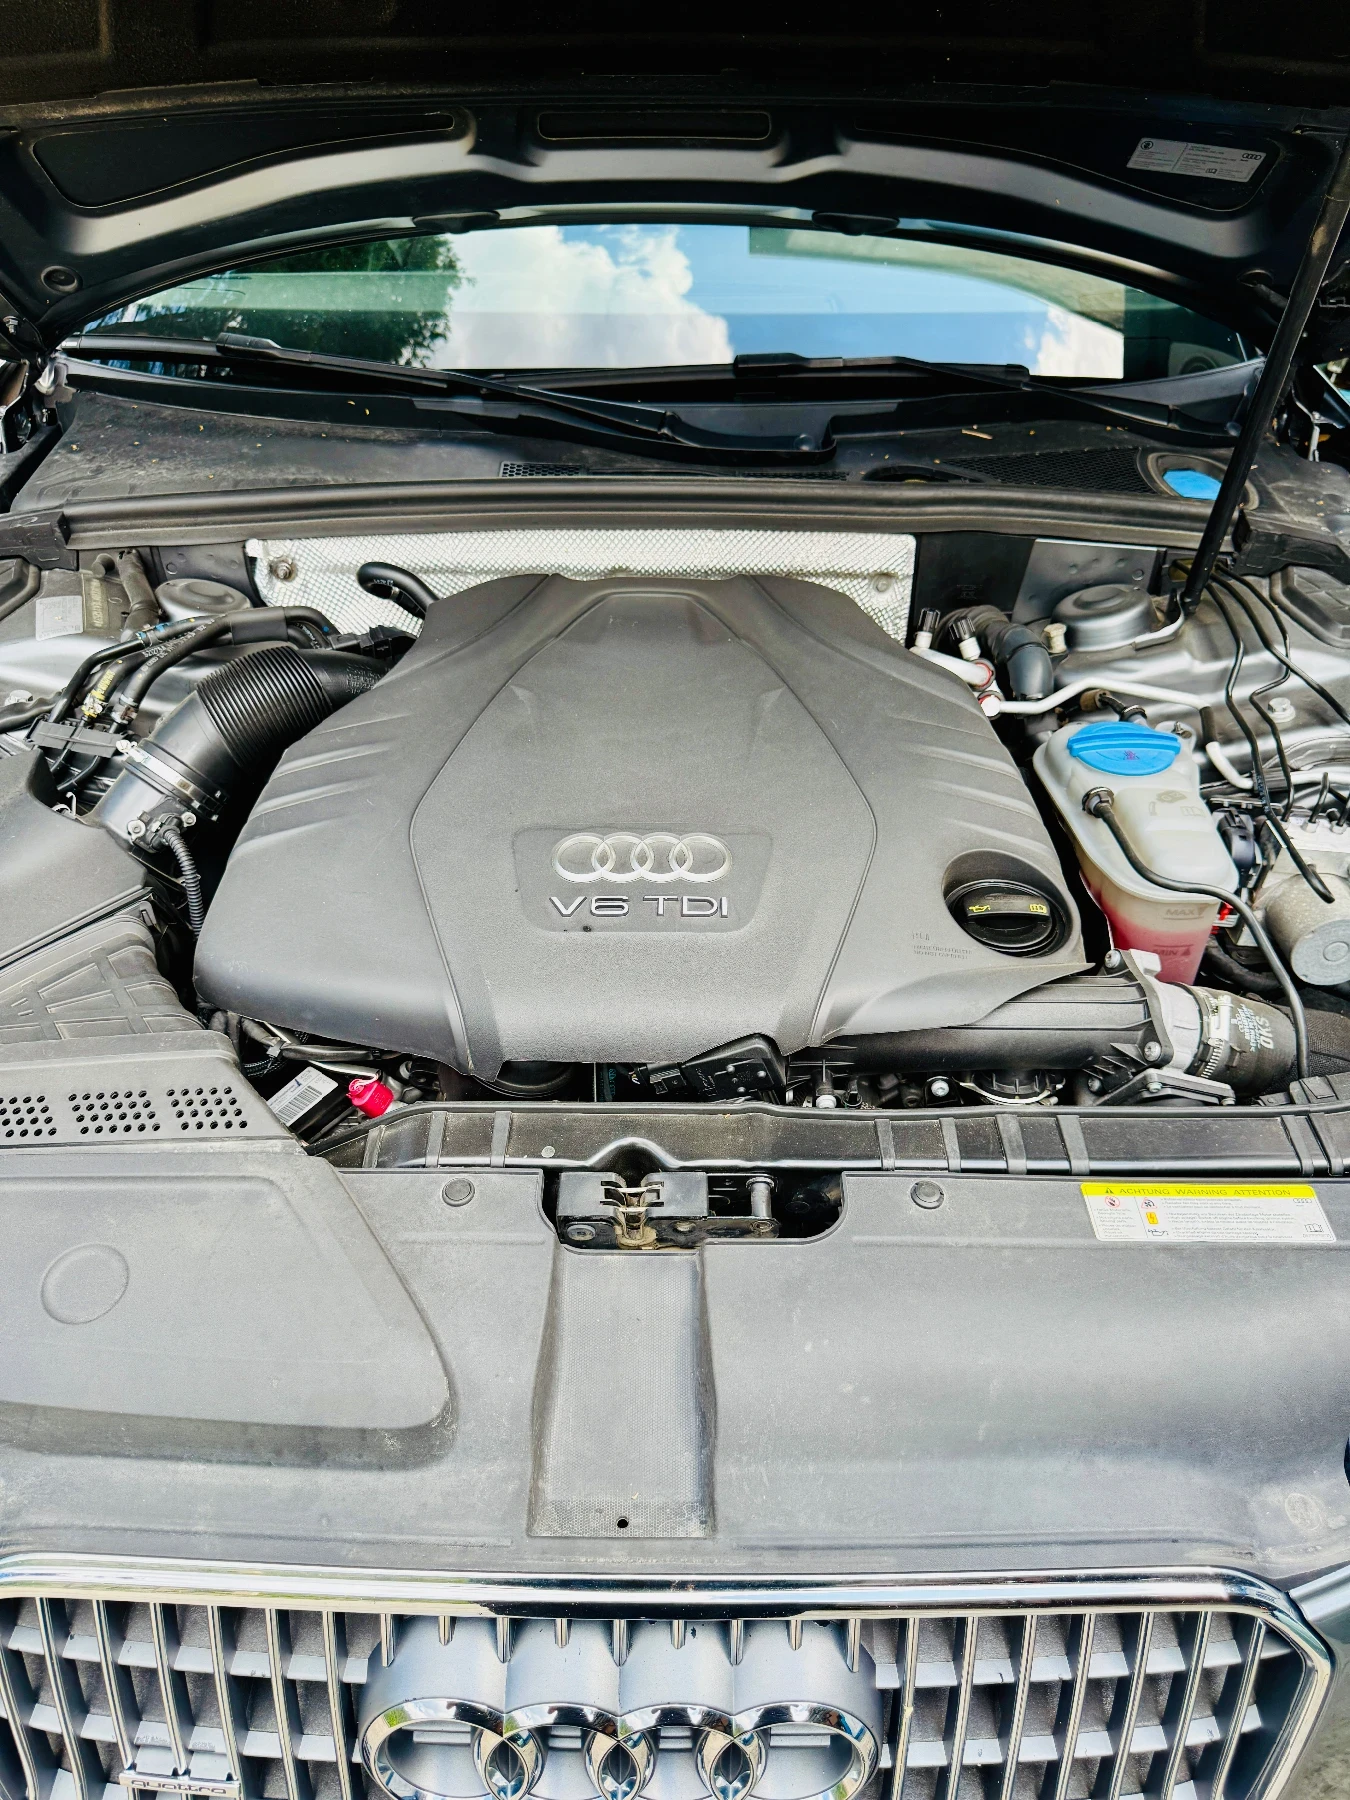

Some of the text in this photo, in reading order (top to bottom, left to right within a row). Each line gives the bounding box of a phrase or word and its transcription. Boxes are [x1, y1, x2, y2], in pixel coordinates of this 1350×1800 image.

[549, 895, 728, 918] V6 TDI
[1165, 908, 1196, 916] MAX
[1176, 1188, 1227, 1196] WARNING
[1233, 1188, 1291, 1196] ATTENTION
[132, 1780, 226, 1794] quattro
